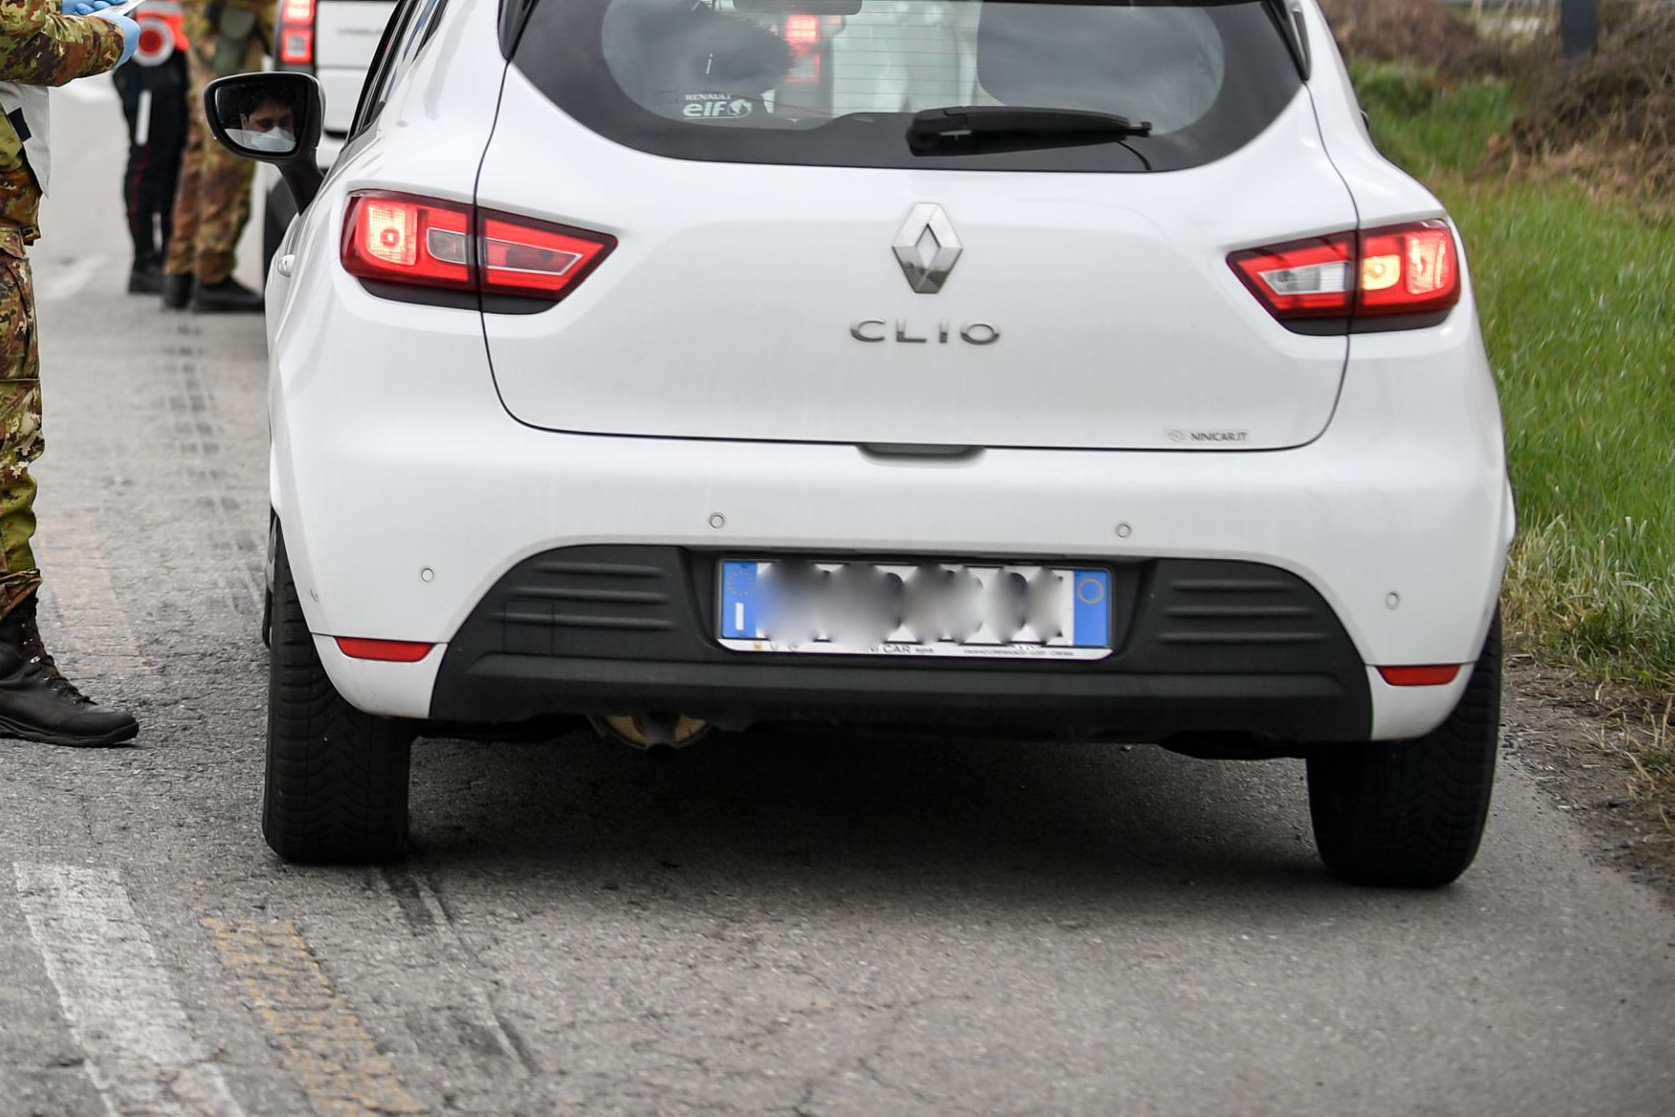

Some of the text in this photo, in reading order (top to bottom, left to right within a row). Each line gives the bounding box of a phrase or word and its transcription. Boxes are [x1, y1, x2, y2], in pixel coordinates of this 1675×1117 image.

[685, 93, 732, 101] RENAULT
[683, 101, 727, 117] elf
[850, 318, 1001, 346] CLIO
